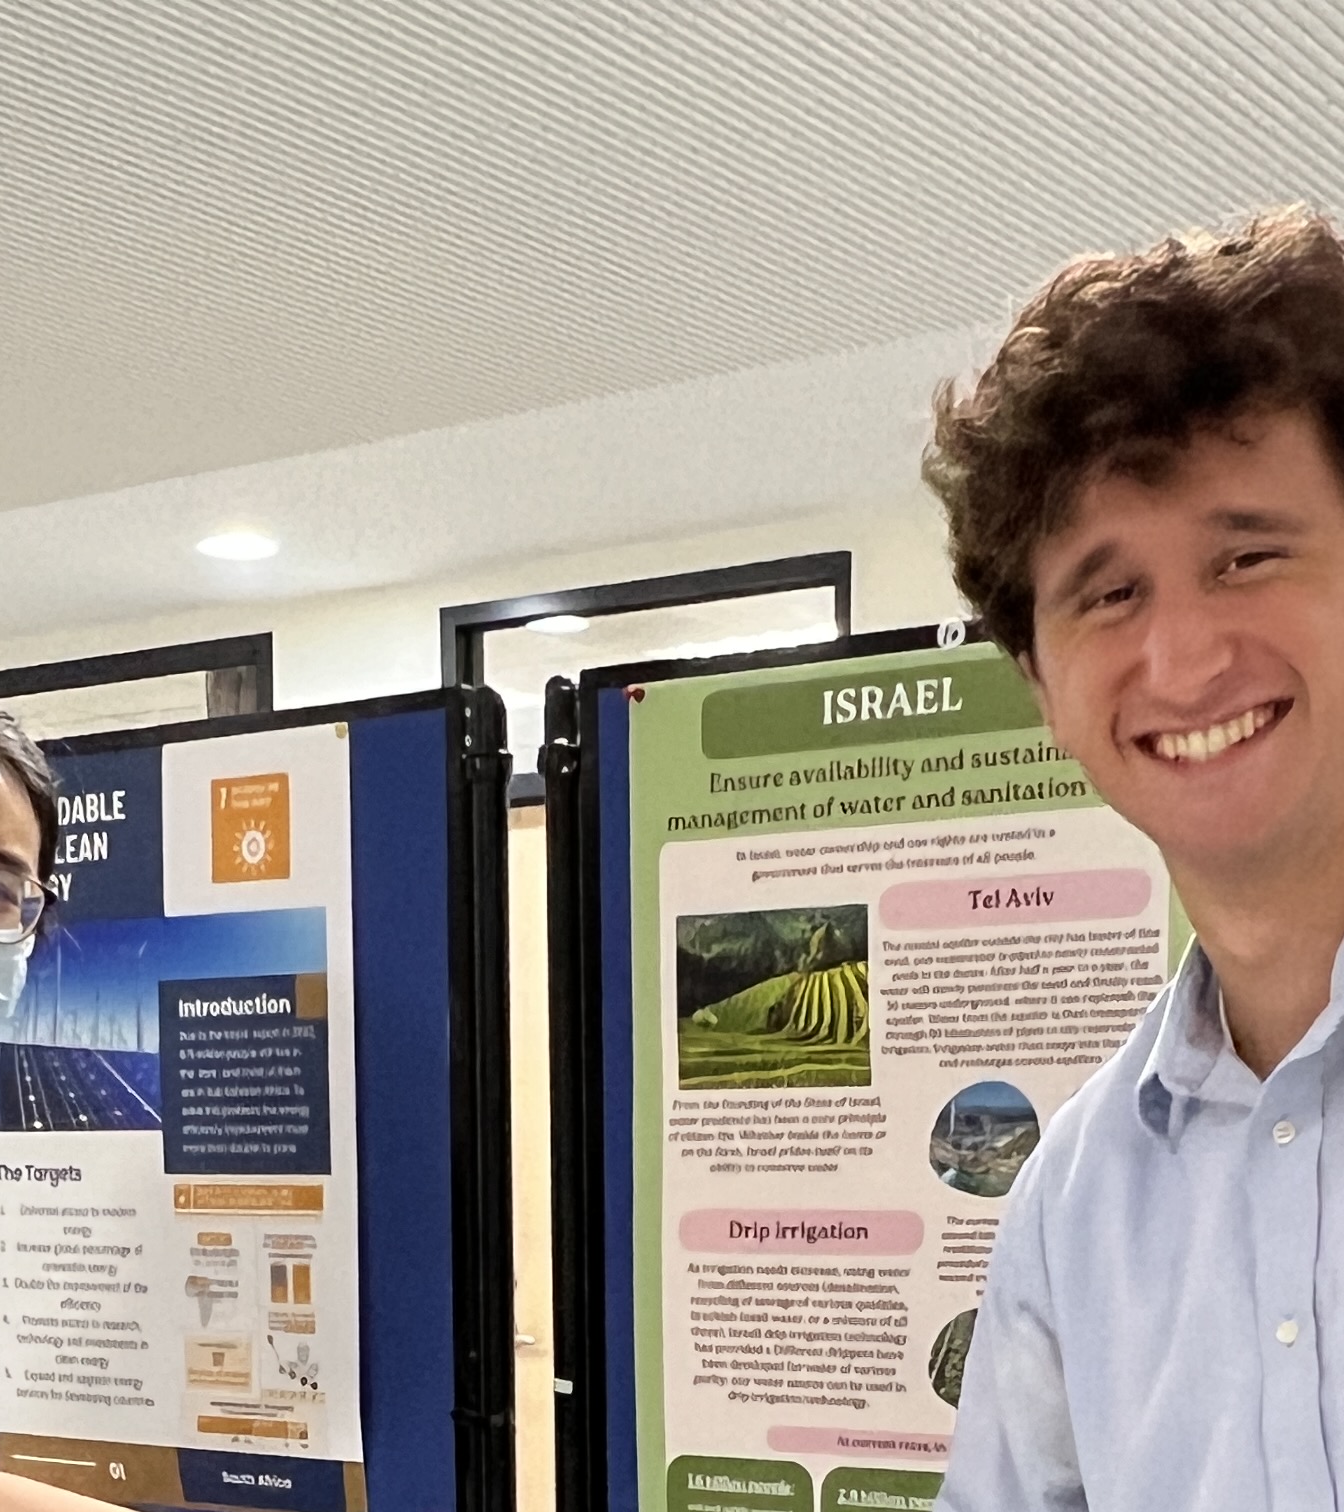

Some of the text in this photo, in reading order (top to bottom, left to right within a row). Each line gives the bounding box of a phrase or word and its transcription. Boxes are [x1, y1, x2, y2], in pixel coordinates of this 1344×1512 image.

[823, 677, 963, 725] ISRAEL
[710, 770, 784, 794] Ensure
[789, 754, 915, 784] availability
[920, 748, 964, 773] and
[57, 789, 126, 826] DABLE
[667, 777, 1087, 831] management of water and sanitation
[54, 831, 108, 865] LEAN
[968, 886, 1055, 910] Tel Aviv
[178, 993, 291, 1018] Introduction
[25, 1166, 82, 1187] Targets
[729, 1219, 770, 1243] Drip
